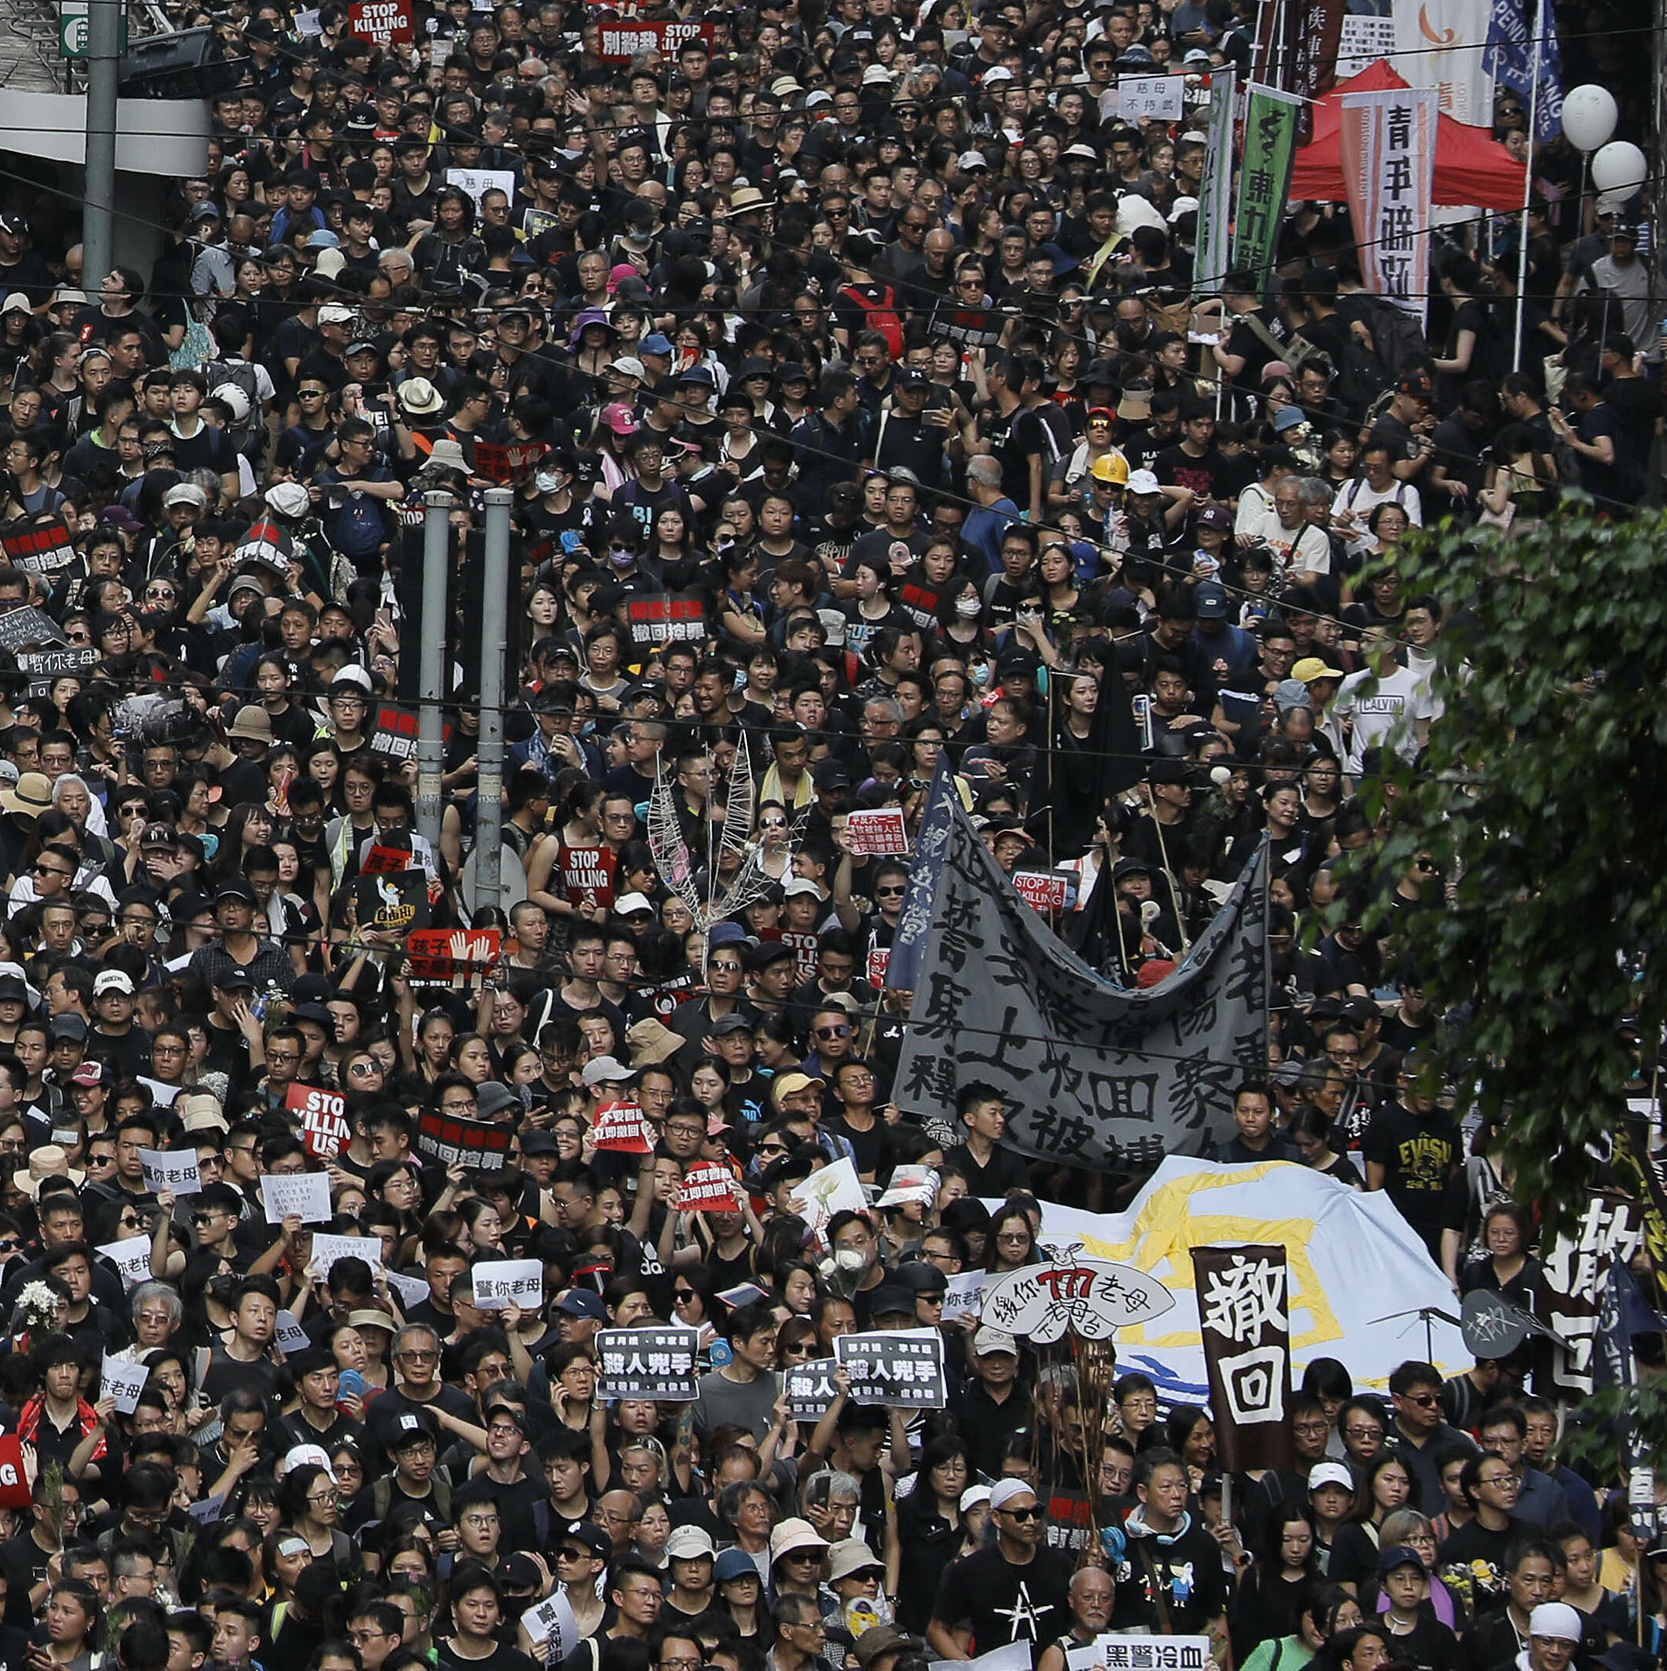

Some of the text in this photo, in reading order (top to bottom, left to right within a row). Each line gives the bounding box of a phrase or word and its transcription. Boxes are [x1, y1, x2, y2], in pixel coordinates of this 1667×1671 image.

[361, 2, 398, 18] STOP
[353, 14, 408, 32] KILLING
[664, 23, 700, 39] STOP
[1136, 81, 1167, 95] 慈母
[631, 620, 706, 644] 撤回控罪
[1362, 696, 1403, 715] CALVIN
[569, 849, 600, 870] STOP
[564, 868, 610, 889] KILLING
[1014, 874, 1043, 890] STOP
[311, 1135, 341, 1157] US
[1399, 1139, 1454, 1161] EVISU
[1037, 1269, 1096, 1301] 777
[1098, 1274, 1152, 1314] 老母
[1203, 1253, 1289, 1427] 撤回
[1105, 1645, 1205, 1671] 黑警冷血
